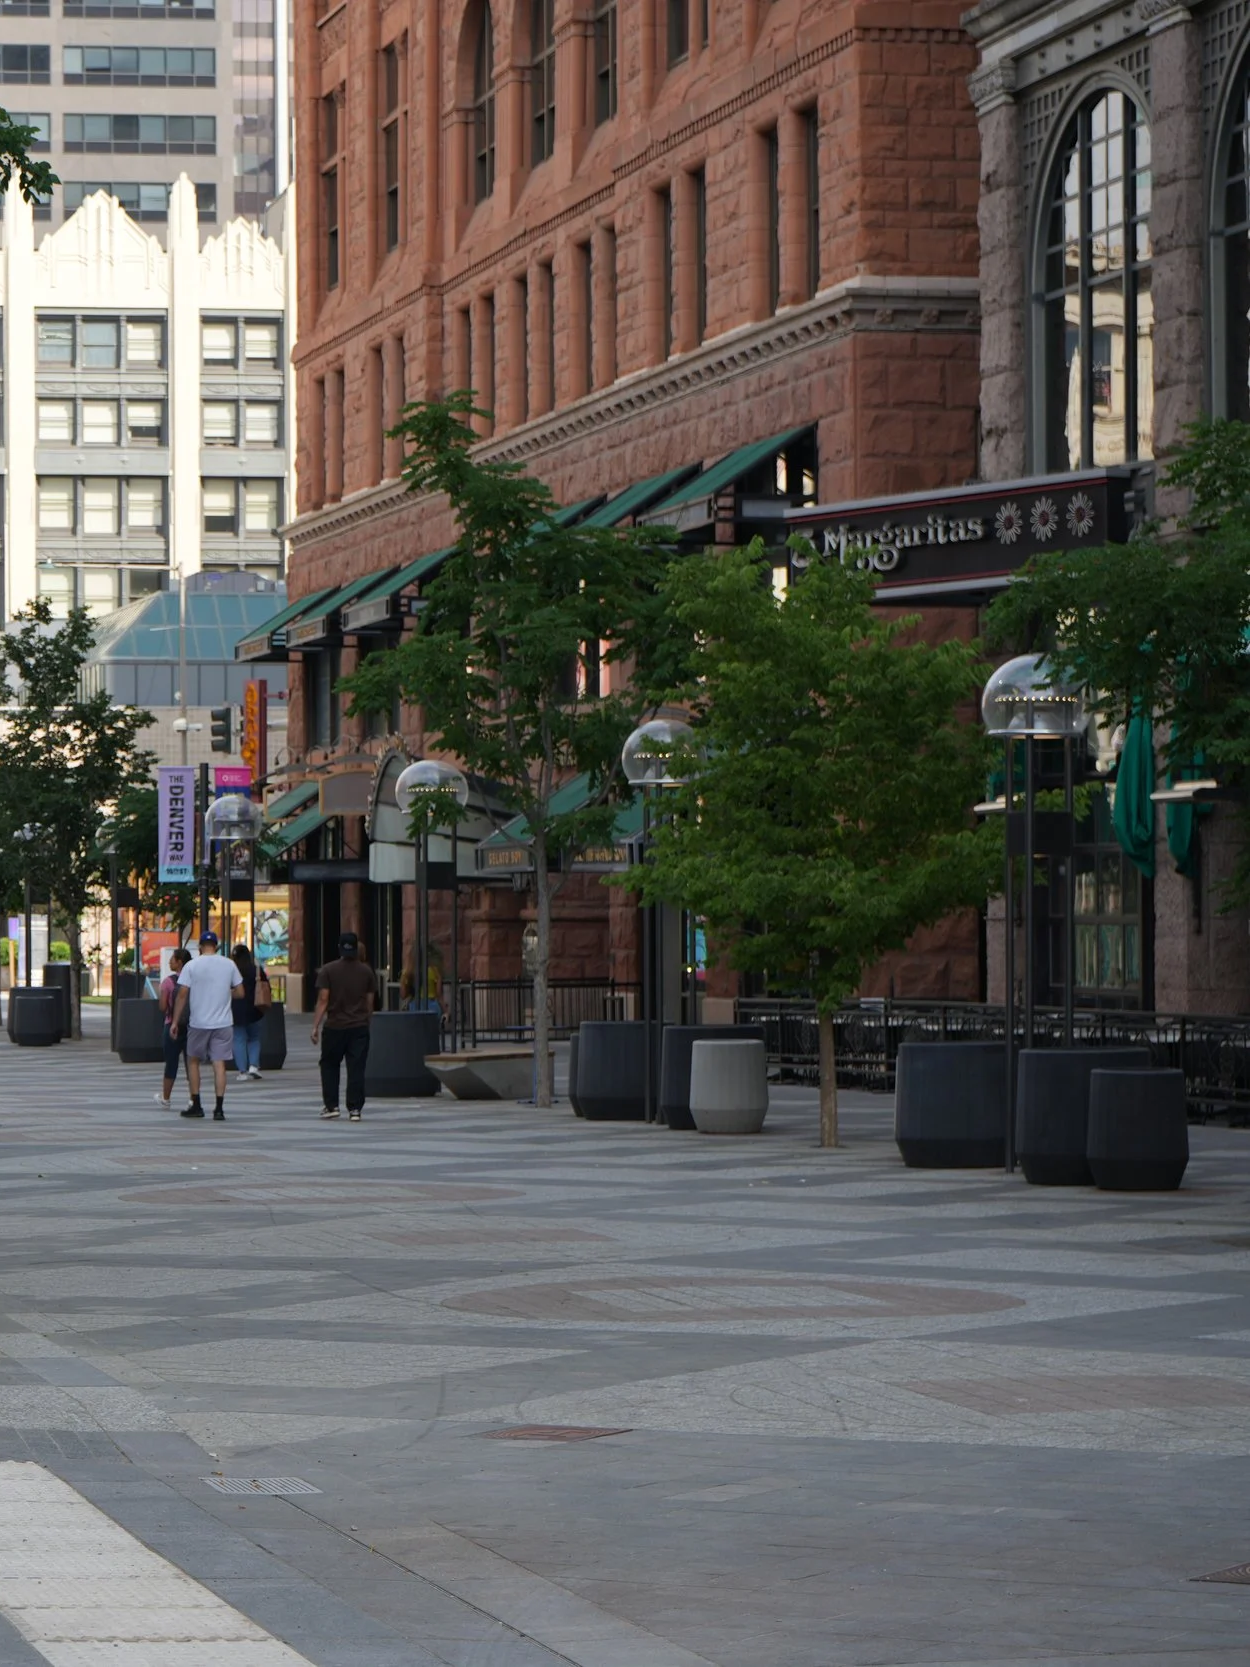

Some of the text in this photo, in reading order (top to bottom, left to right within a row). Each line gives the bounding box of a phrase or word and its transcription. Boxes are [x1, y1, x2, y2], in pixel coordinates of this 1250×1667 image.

[823, 512, 985, 572] Margaritas
[169, 786, 184, 852] DENVER
[169, 854, 184, 862] WAY
